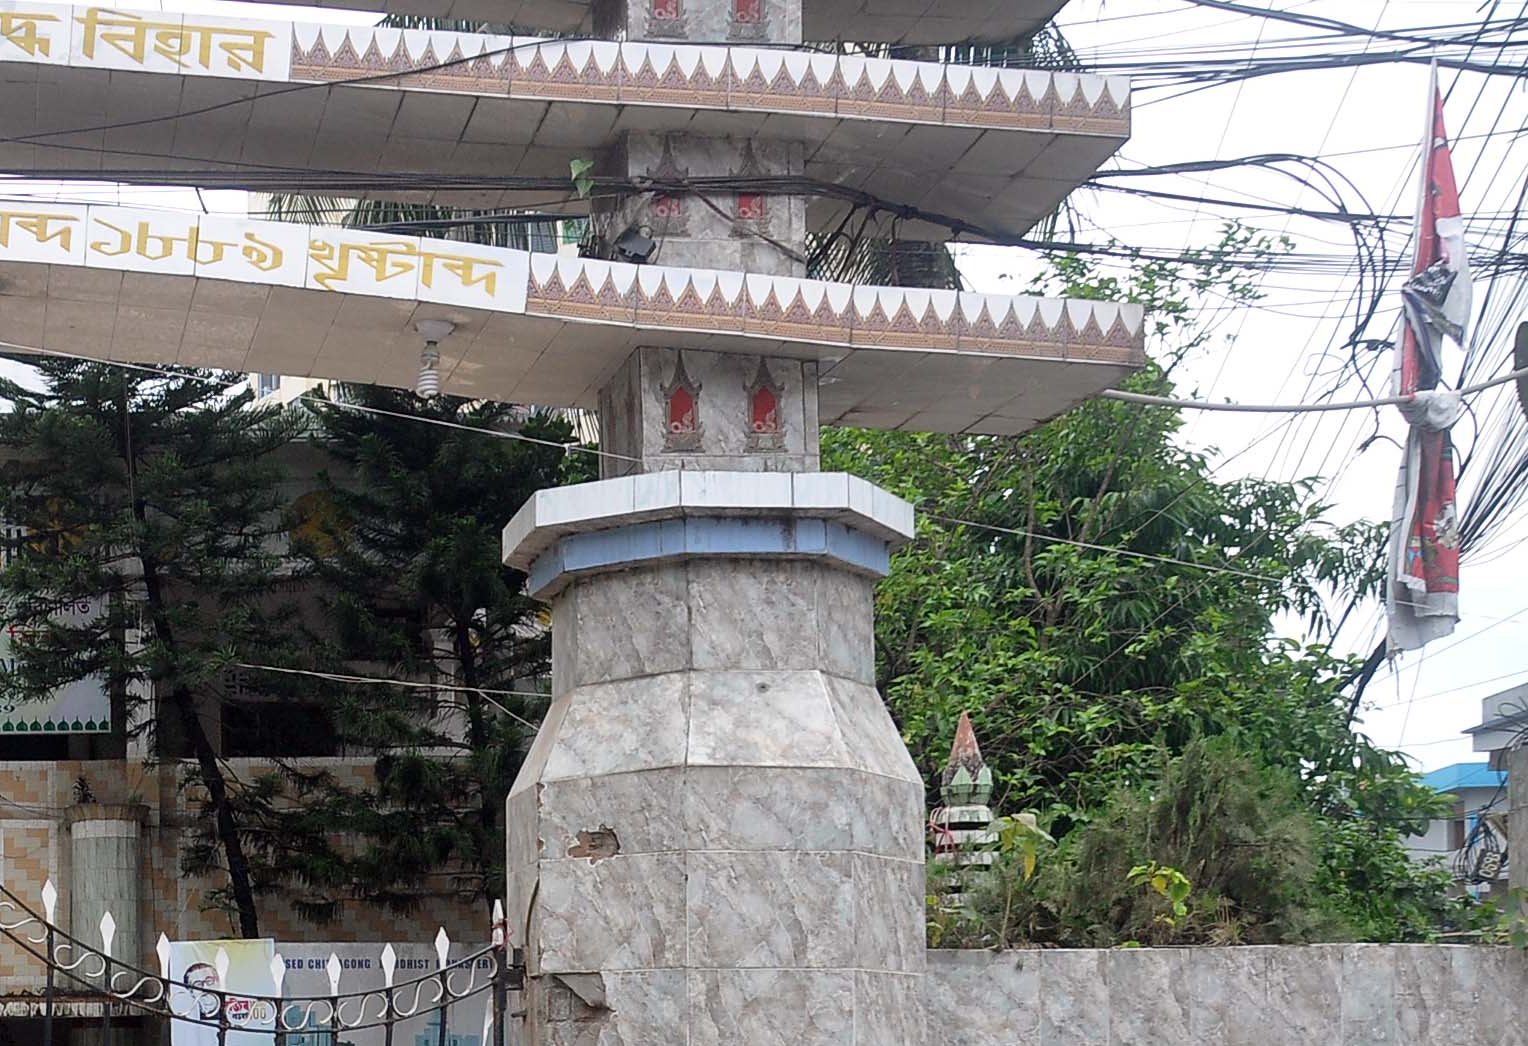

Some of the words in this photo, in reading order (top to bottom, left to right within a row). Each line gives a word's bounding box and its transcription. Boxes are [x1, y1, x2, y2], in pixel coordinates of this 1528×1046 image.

[75, 7, 276, 74] বিহার
[90, 217, 283, 272] ১৮৮৯
[308, 959, 371, 970] CHIAGONG
